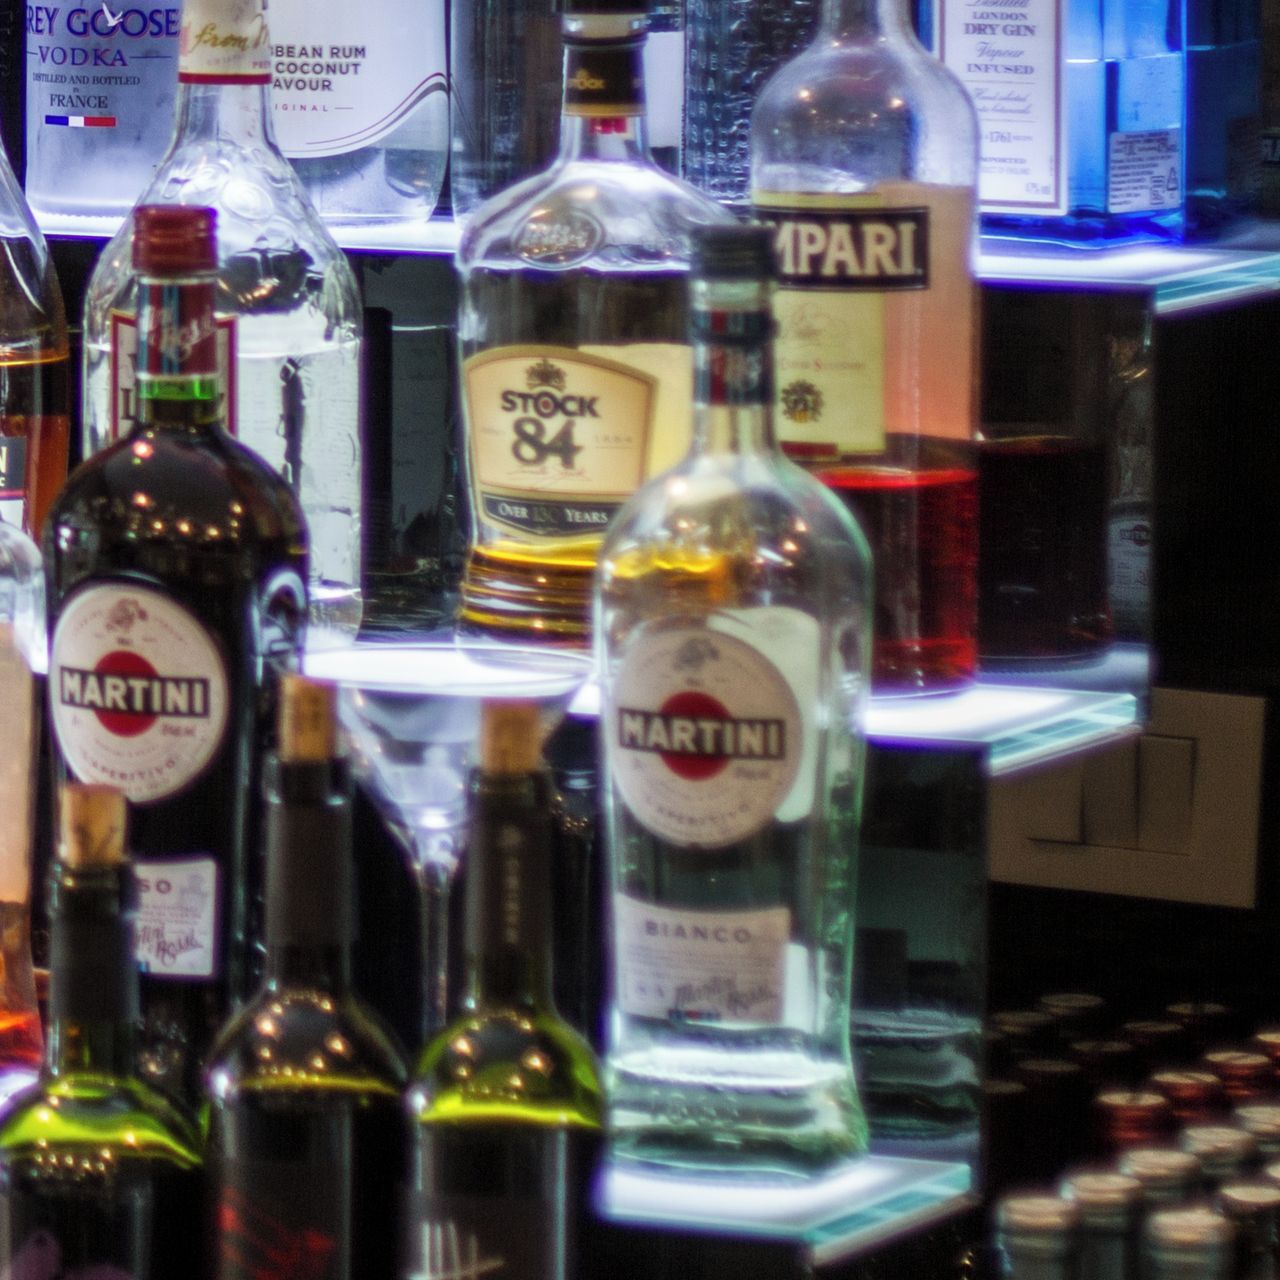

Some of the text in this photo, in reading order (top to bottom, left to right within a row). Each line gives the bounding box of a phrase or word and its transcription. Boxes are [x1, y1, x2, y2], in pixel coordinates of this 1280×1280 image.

[66, 7, 179, 39] GOOSE
[972, 10, 1028, 22] LONDON
[964, 22, 1036, 38] DRY GIN
[37, 45, 128, 67] VODKA
[329, 45, 367, 59] RUM
[274, 61, 361, 76] COCONUT
[966, 63, 1035, 75] INFUSED
[68, 75, 91, 86] AND
[91, 76, 141, 87] BOTTLED
[273, 77, 333, 92] AVOUR
[49, 93, 109, 111] FRANCE
[774, 220, 919, 277] MPARI
[501, 389, 600, 418] STOCK
[511, 417, 584, 470] 84
[61, 670, 206, 715] MARTINI
[621, 715, 780, 757] MARTINI
[645, 922, 751, 943] BIANCO
